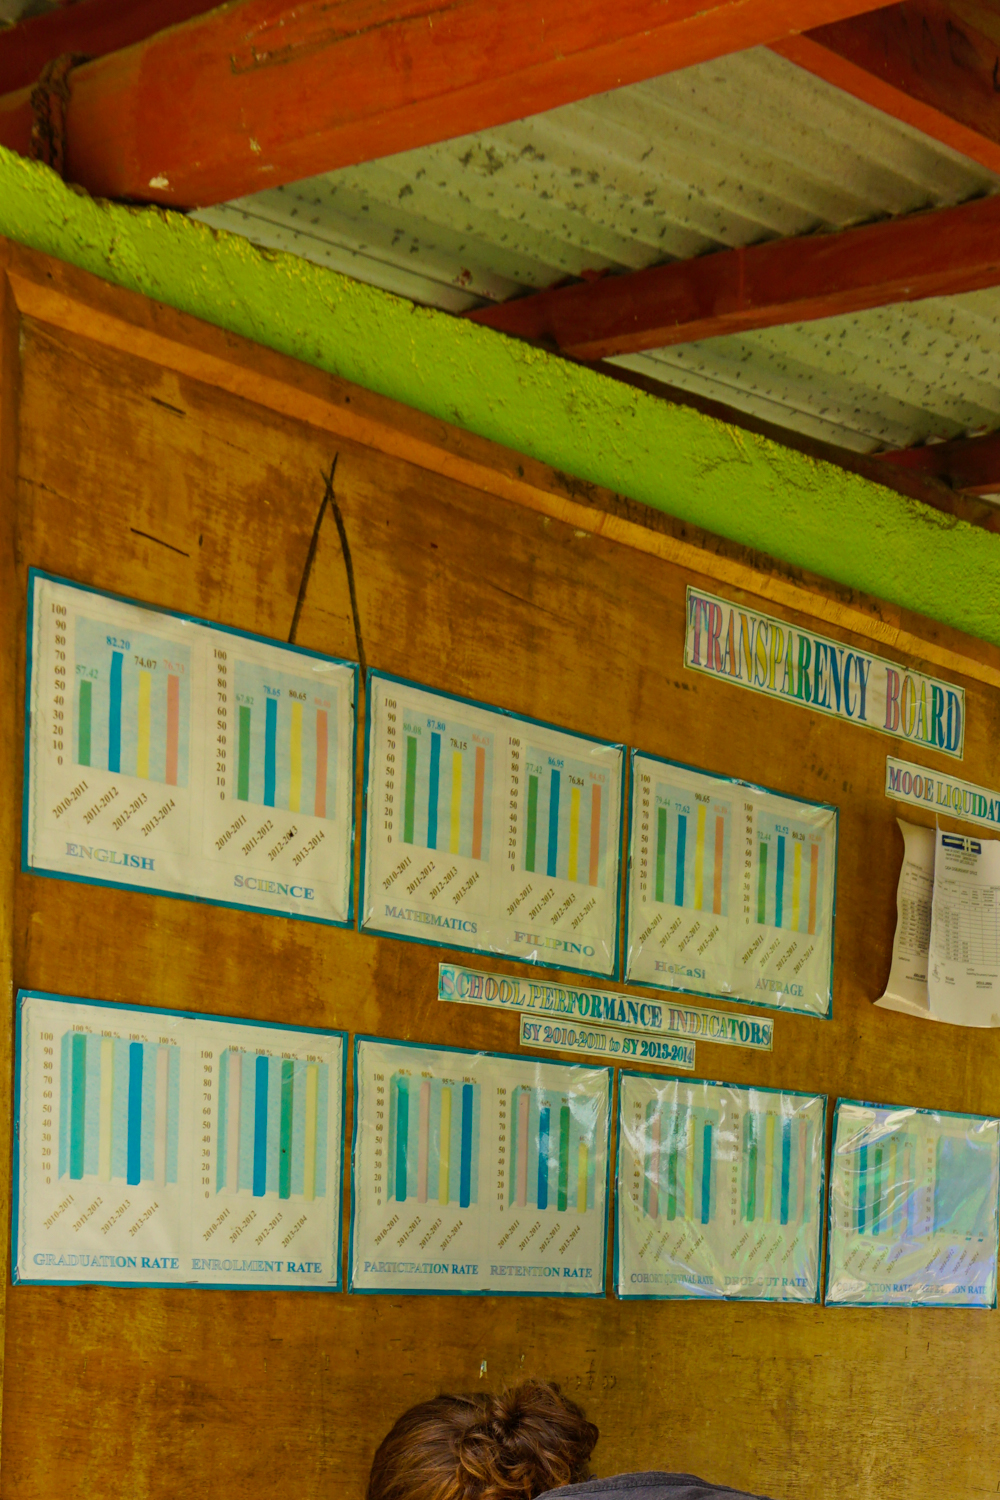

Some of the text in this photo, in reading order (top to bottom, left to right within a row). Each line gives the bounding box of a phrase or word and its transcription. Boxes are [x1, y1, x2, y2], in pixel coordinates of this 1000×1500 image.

[51, 603, 67, 616] 100
[55, 620, 67, 631] 90
[55, 635, 66, 646] 80
[106, 636, 130, 650] 82.20
[55, 650, 66, 661] 70
[134, 655, 157, 670] 74.07
[54, 665, 66, 676] 60
[689, 595, 962, 752] TRANSPARENCY BOARD
[54, 680, 65, 691] 50
[53, 694, 64, 705] 40
[384, 698, 397, 709] 100
[53, 709, 64, 720] 30
[387, 713, 396, 722] 90
[427, 719, 446, 731] 87.80
[52, 724, 64, 735] 20
[387, 726, 396, 735] 80
[52, 739, 63, 750] 10
[387, 740, 396, 749] 70
[450, 738, 468, 750] 78.15
[57, 755, 63, 766] 0
[386, 754, 395, 763] 60
[386, 767, 395, 776] 50
[385, 781, 394, 790] 40
[888, 766, 934, 802] MOOE
[52, 780, 89, 819] 2010-2011
[83, 787, 119, 825] 2011-2012
[112, 792, 148, 831] 2012-2013
[384, 807, 393, 816] 20
[385, 794, 394, 803] 30
[141, 799, 176, 836] 2013-2014
[384, 821, 393, 830] 10
[215, 814, 247, 851] 2010-2011
[242, 820, 274, 856] 2011-2012
[387, 834, 392, 844] 0
[65, 842, 155, 871] ENGLISH
[292, 830, 326, 867] 2013-2014
[382, 856, 412, 890] 2010-2011
[406, 861, 436, 895] 2011-2012
[429, 866, 458, 900] 2012-2013
[234, 874, 315, 900] SCIENCE
[452, 871, 480, 905] 2013-2014
[506, 883, 533, 916] 2010-2011
[528, 888, 556, 921] 2011-2012
[550, 893, 577, 925] 2012-2013
[571, 897, 597, 930] 2013-2014
[385, 904, 478, 934] MATHEMATICS
[639, 913, 663, 944] 2010-2011
[513, 931, 596, 957] FILIPINO
[660, 917, 682, 948] 2011-2012
[678, 921, 701, 952] 2012-2013
[697, 925, 719, 956] 2013-2014
[742, 935, 764, 964] 2010-2011
[760, 938, 780, 967] 2011-2012
[776, 941, 797, 971] 2012-2013
[793, 945, 814, 974] 2013-2014
[654, 960, 706, 979] HeKaSi
[755, 978, 804, 997] AVERAGE
[441, 969, 771, 1045] SCHOOL PERFORMANCE INDICATORS
[200, 1051, 213, 1059] 100
[523, 1022, 694, 1064] SY 2010-2011 to SY 2013-2014
[204, 1065, 212, 1073] 90
[203, 1079, 212, 1088] 80
[203, 1093, 212, 1101] 70
[203, 1107, 211, 1116] 60
[202, 1121, 211, 1129] 50
[202, 1135, 211, 1143] 40
[202, 1149, 210, 1157] 30
[202, 1163, 210, 1171] 20
[202, 1177, 210, 1185] 10
[205, 1191, 210, 1199] 0
[43, 1194, 75, 1230] 2010-2011
[72, 1197, 104, 1232] 2011-2012
[101, 1199, 132, 1235] 2012-2013
[129, 1202, 160, 1237] 2013-2014
[202, 1208, 231, 1242] 2010-2011
[229, 1210, 258, 1244] 2011-2012
[254, 1212, 284, 1246] 2012-2013
[374, 1214, 400, 1246] 2010-2011
[397, 1216, 422, 1248] 2011-2012
[419, 1218, 442, 1250] 2012-2013
[440, 1220, 463, 1251] 2013-2014
[497, 1220, 520, 1249] 2010-2011
[519, 1221, 541, 1251] 2011-2012
[539, 1223, 561, 1253] 2012-2013
[559, 1225, 581, 1255] 2013-2014
[33, 1253, 180, 1269] GRADUATION RATE
[191, 1259, 323, 1274] ENROLMENT RATE
[364, 1261, 479, 1275] PARTICIPATION RATE
[490, 1265, 592, 1278] RETENTION RATE
